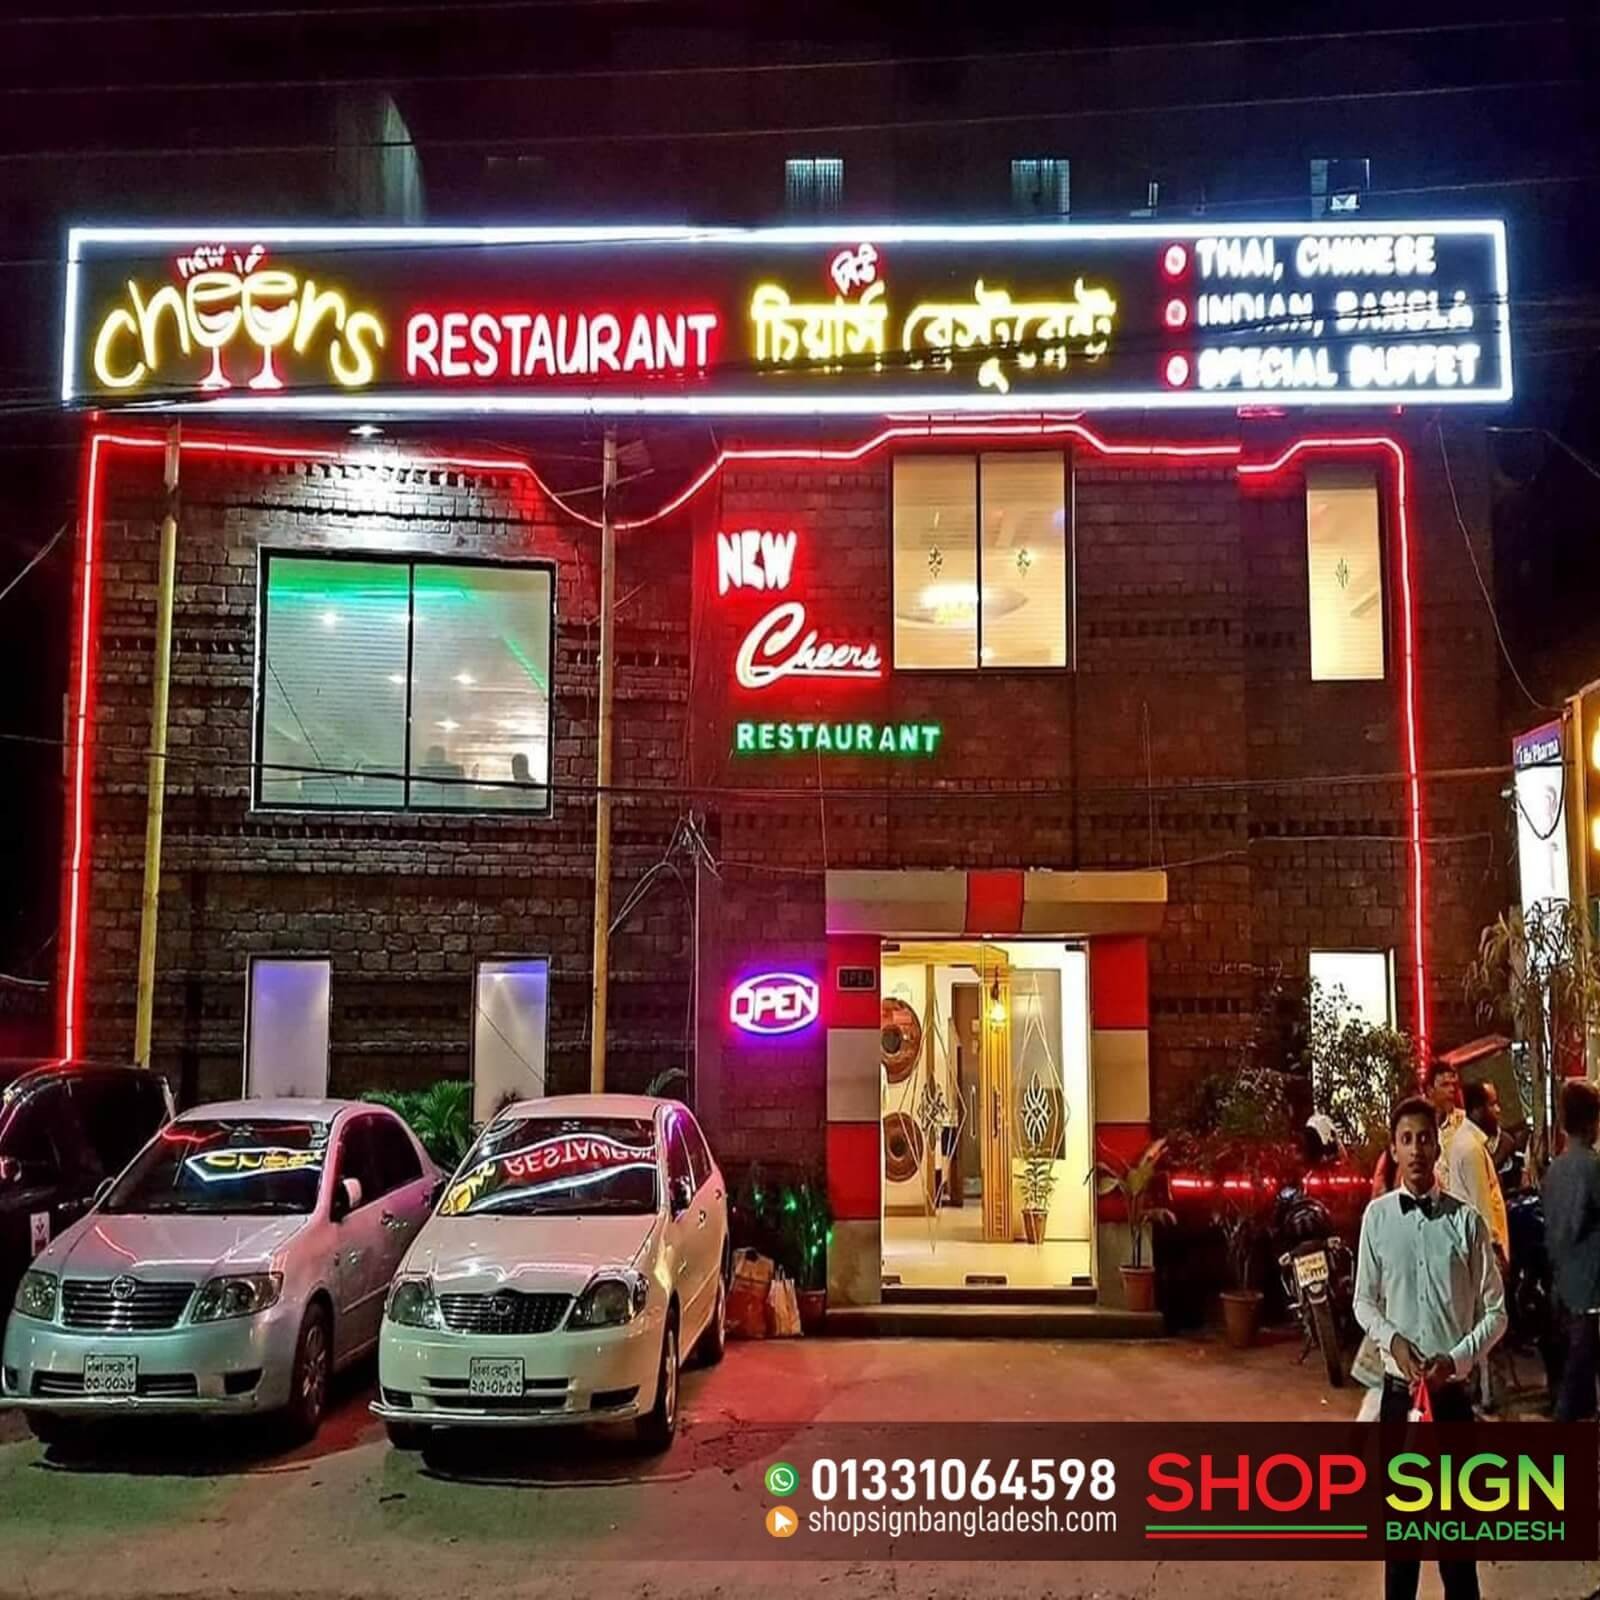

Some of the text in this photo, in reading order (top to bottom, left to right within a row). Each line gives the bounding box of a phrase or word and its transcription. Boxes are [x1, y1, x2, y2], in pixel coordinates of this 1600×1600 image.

[1196, 235, 1436, 283] THAI, CHINESE
[94, 270, 718, 389] cheers RESTAURANT
[1198, 344, 1480, 389] SPECIAL BUFFET
[717, 530, 797, 596] NEW
[736, 602, 882, 688] Cheers
[737, 723, 941, 752] RESTAURANT
[731, 984, 819, 1024] OPEN
